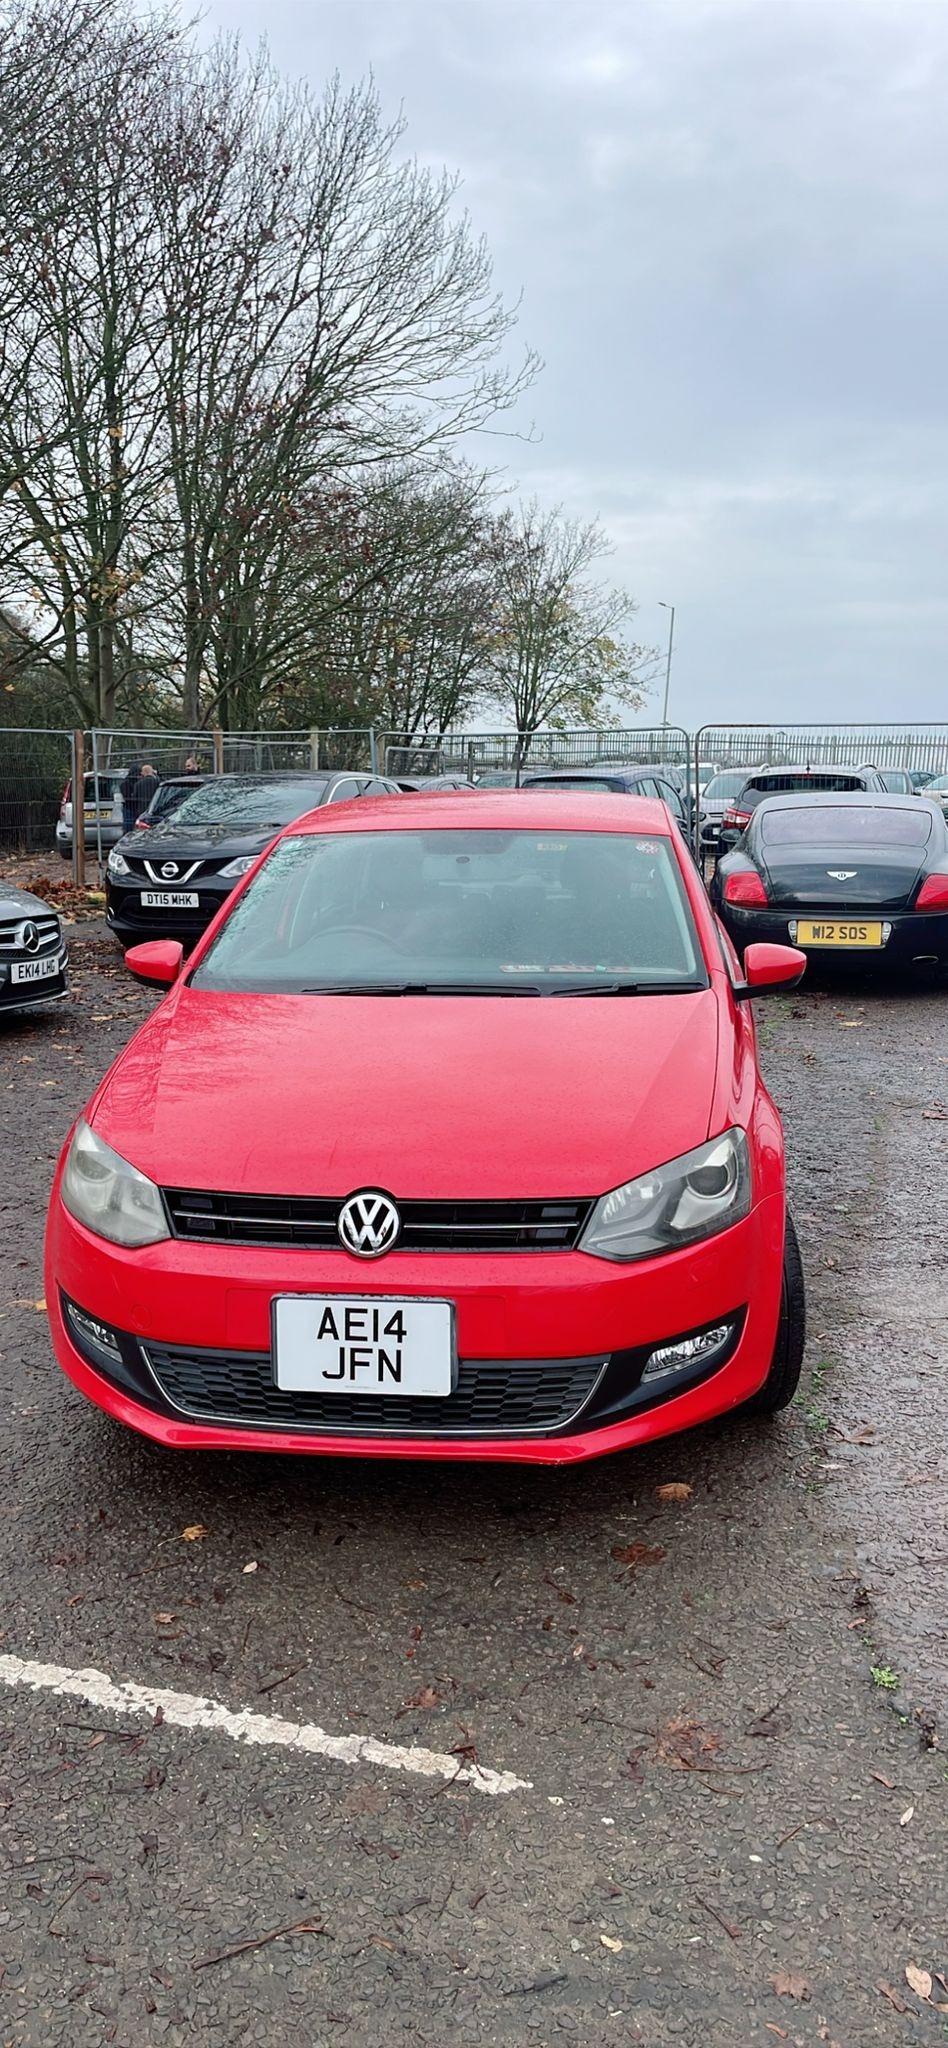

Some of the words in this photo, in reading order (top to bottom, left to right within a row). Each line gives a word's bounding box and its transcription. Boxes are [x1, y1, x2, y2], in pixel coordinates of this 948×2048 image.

[147, 893, 169, 905] DT15
[171, 894, 193, 906] MHK
[838, 926, 867, 940] SOS
[18, 962, 40, 979] EK14
[317, 1307, 407, 1343] AE14
[322, 1347, 402, 1383] JFN
